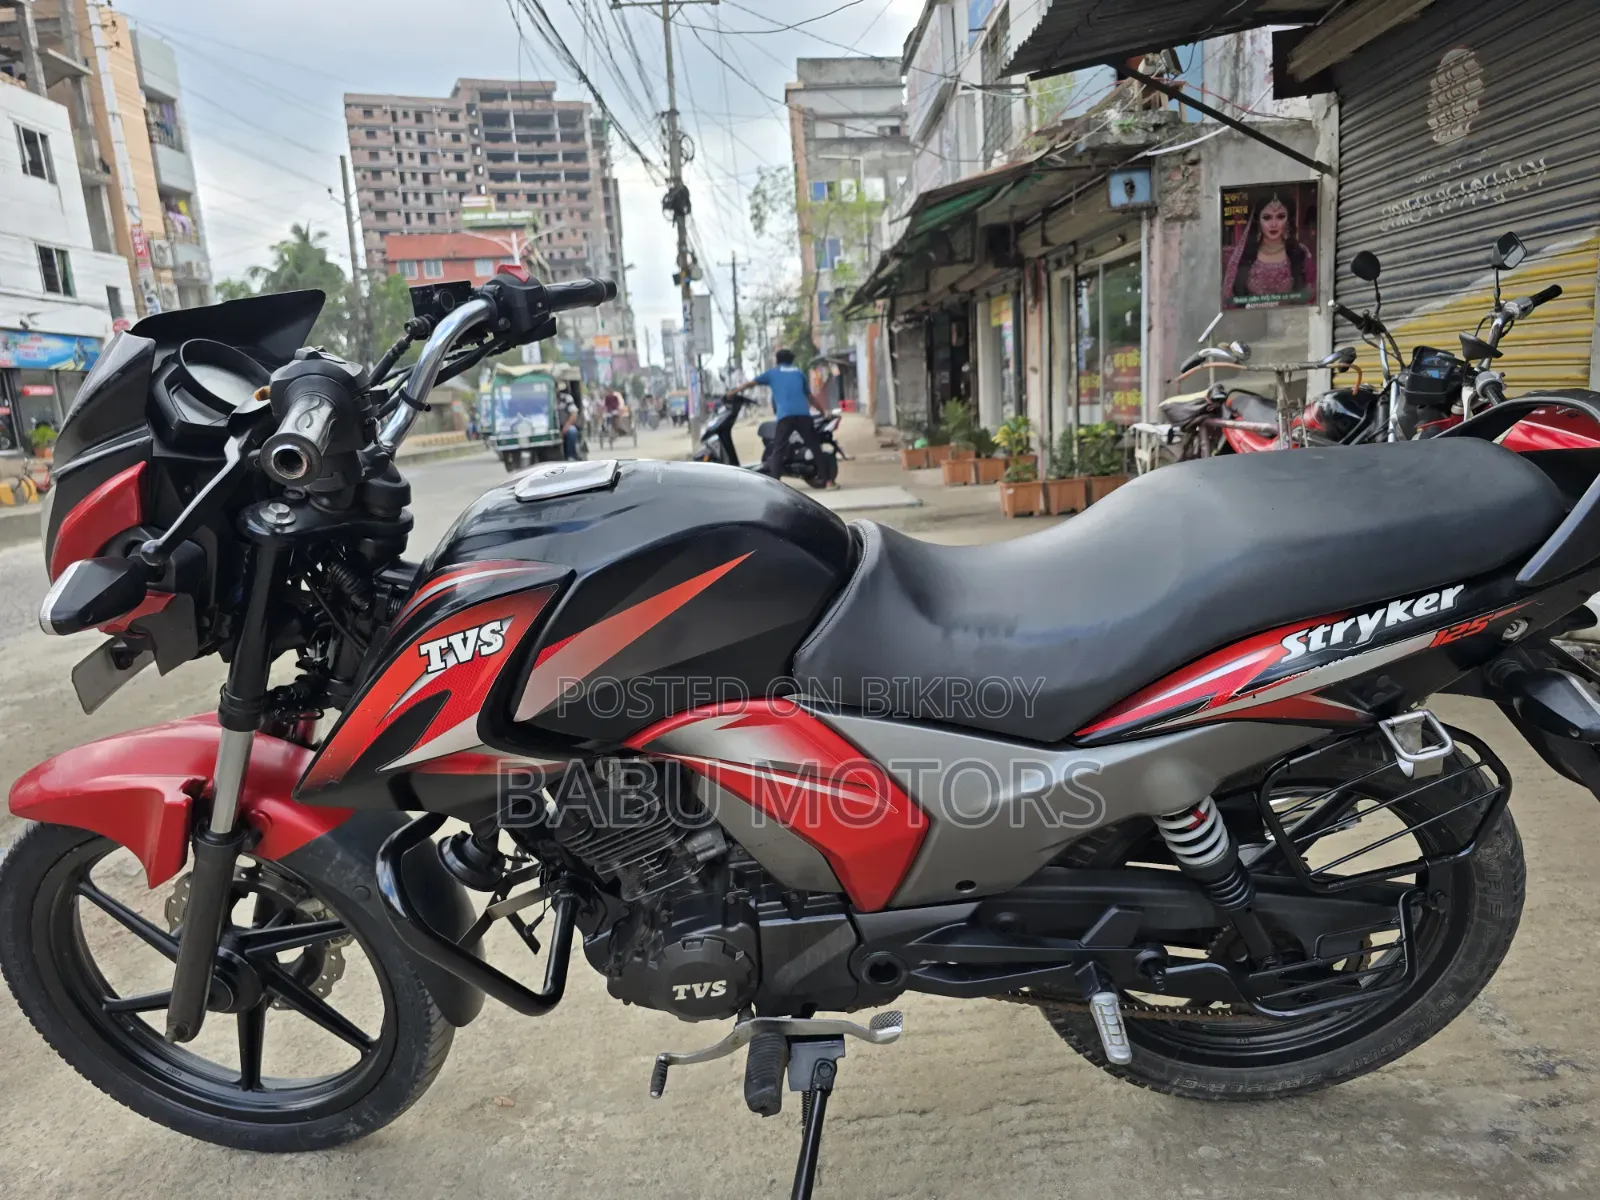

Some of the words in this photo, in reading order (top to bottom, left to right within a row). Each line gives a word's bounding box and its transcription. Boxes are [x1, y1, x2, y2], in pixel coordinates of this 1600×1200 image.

[418, 619, 506, 675] TVS
[1280, 584, 1465, 663] Stryker
[1429, 612, 1498, 648] 125
[672, 980, 727, 1001] TVS
